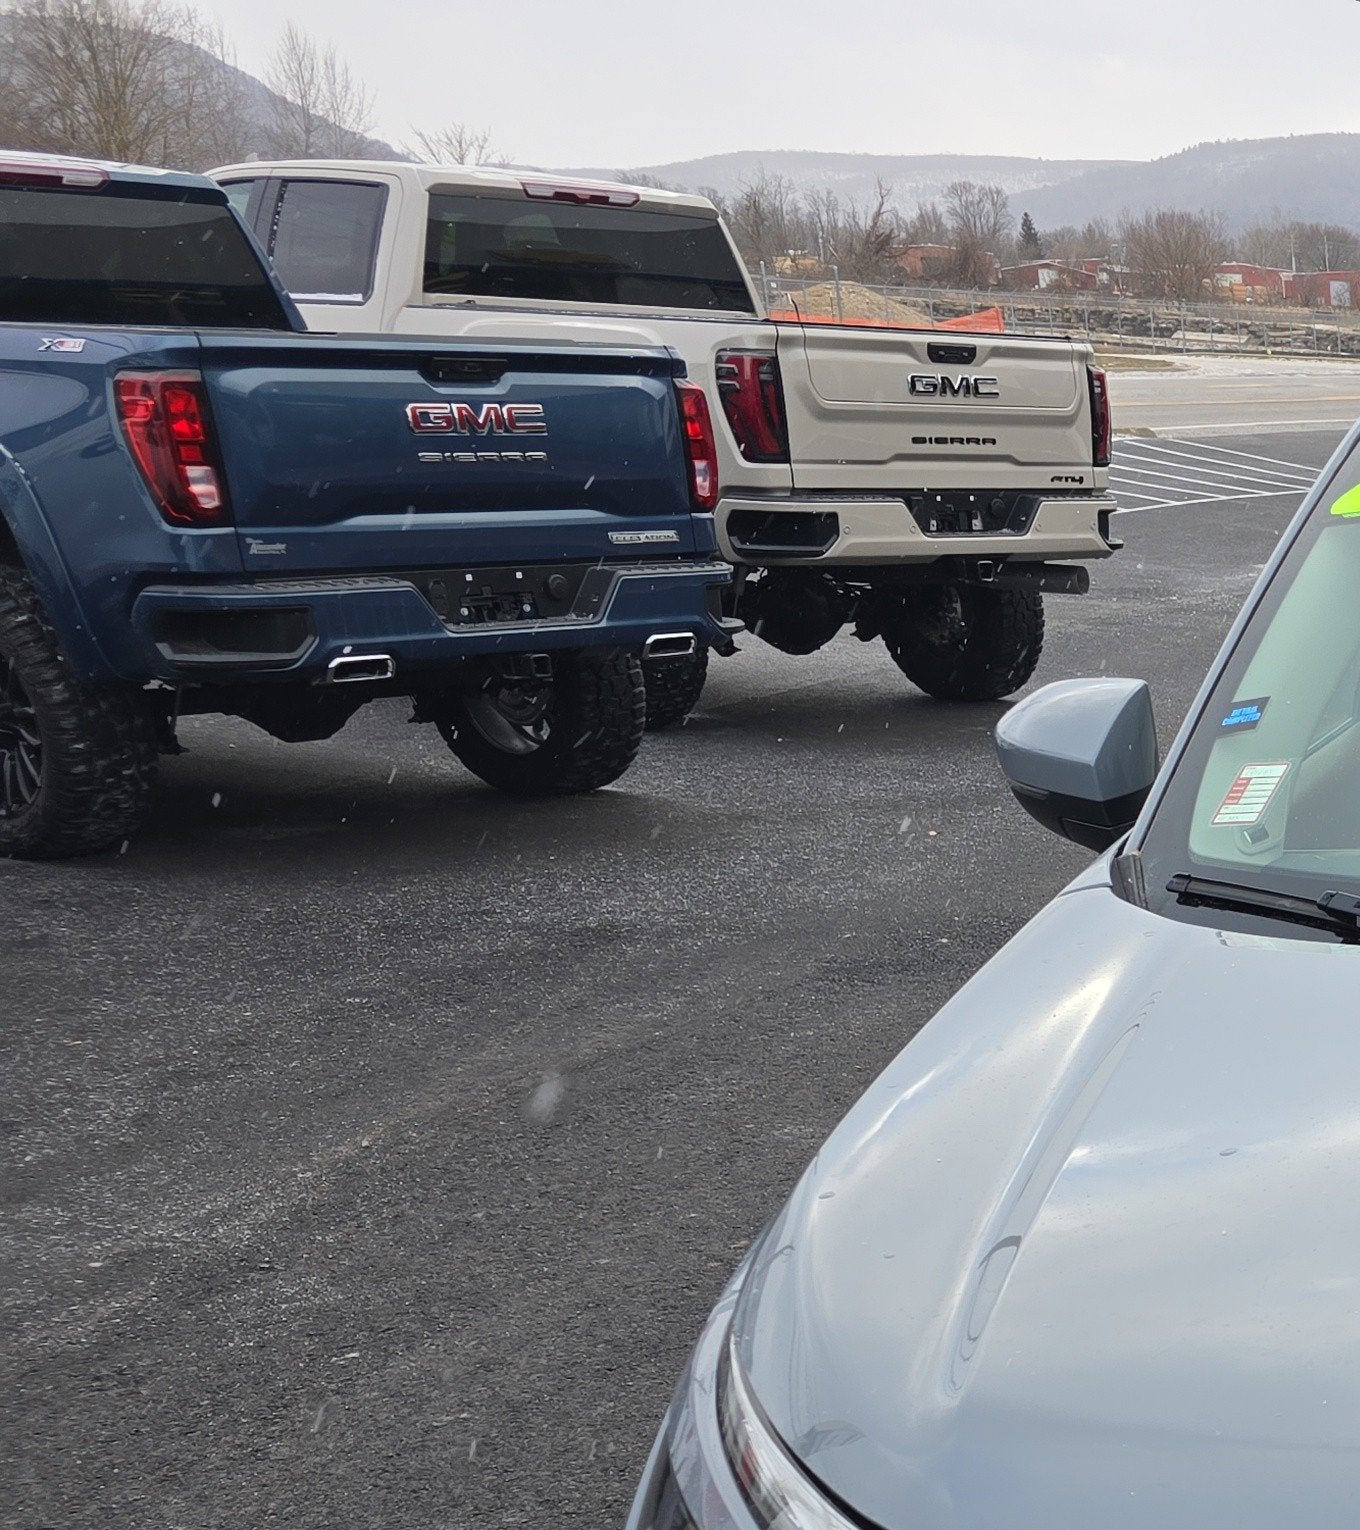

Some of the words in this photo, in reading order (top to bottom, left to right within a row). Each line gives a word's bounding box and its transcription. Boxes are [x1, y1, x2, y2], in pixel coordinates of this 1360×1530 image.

[908, 373, 1000, 398] GMC
[406, 403, 548, 434] GMC
[911, 437, 997, 446] SIERRA
[417, 452, 548, 462] SIERRA
